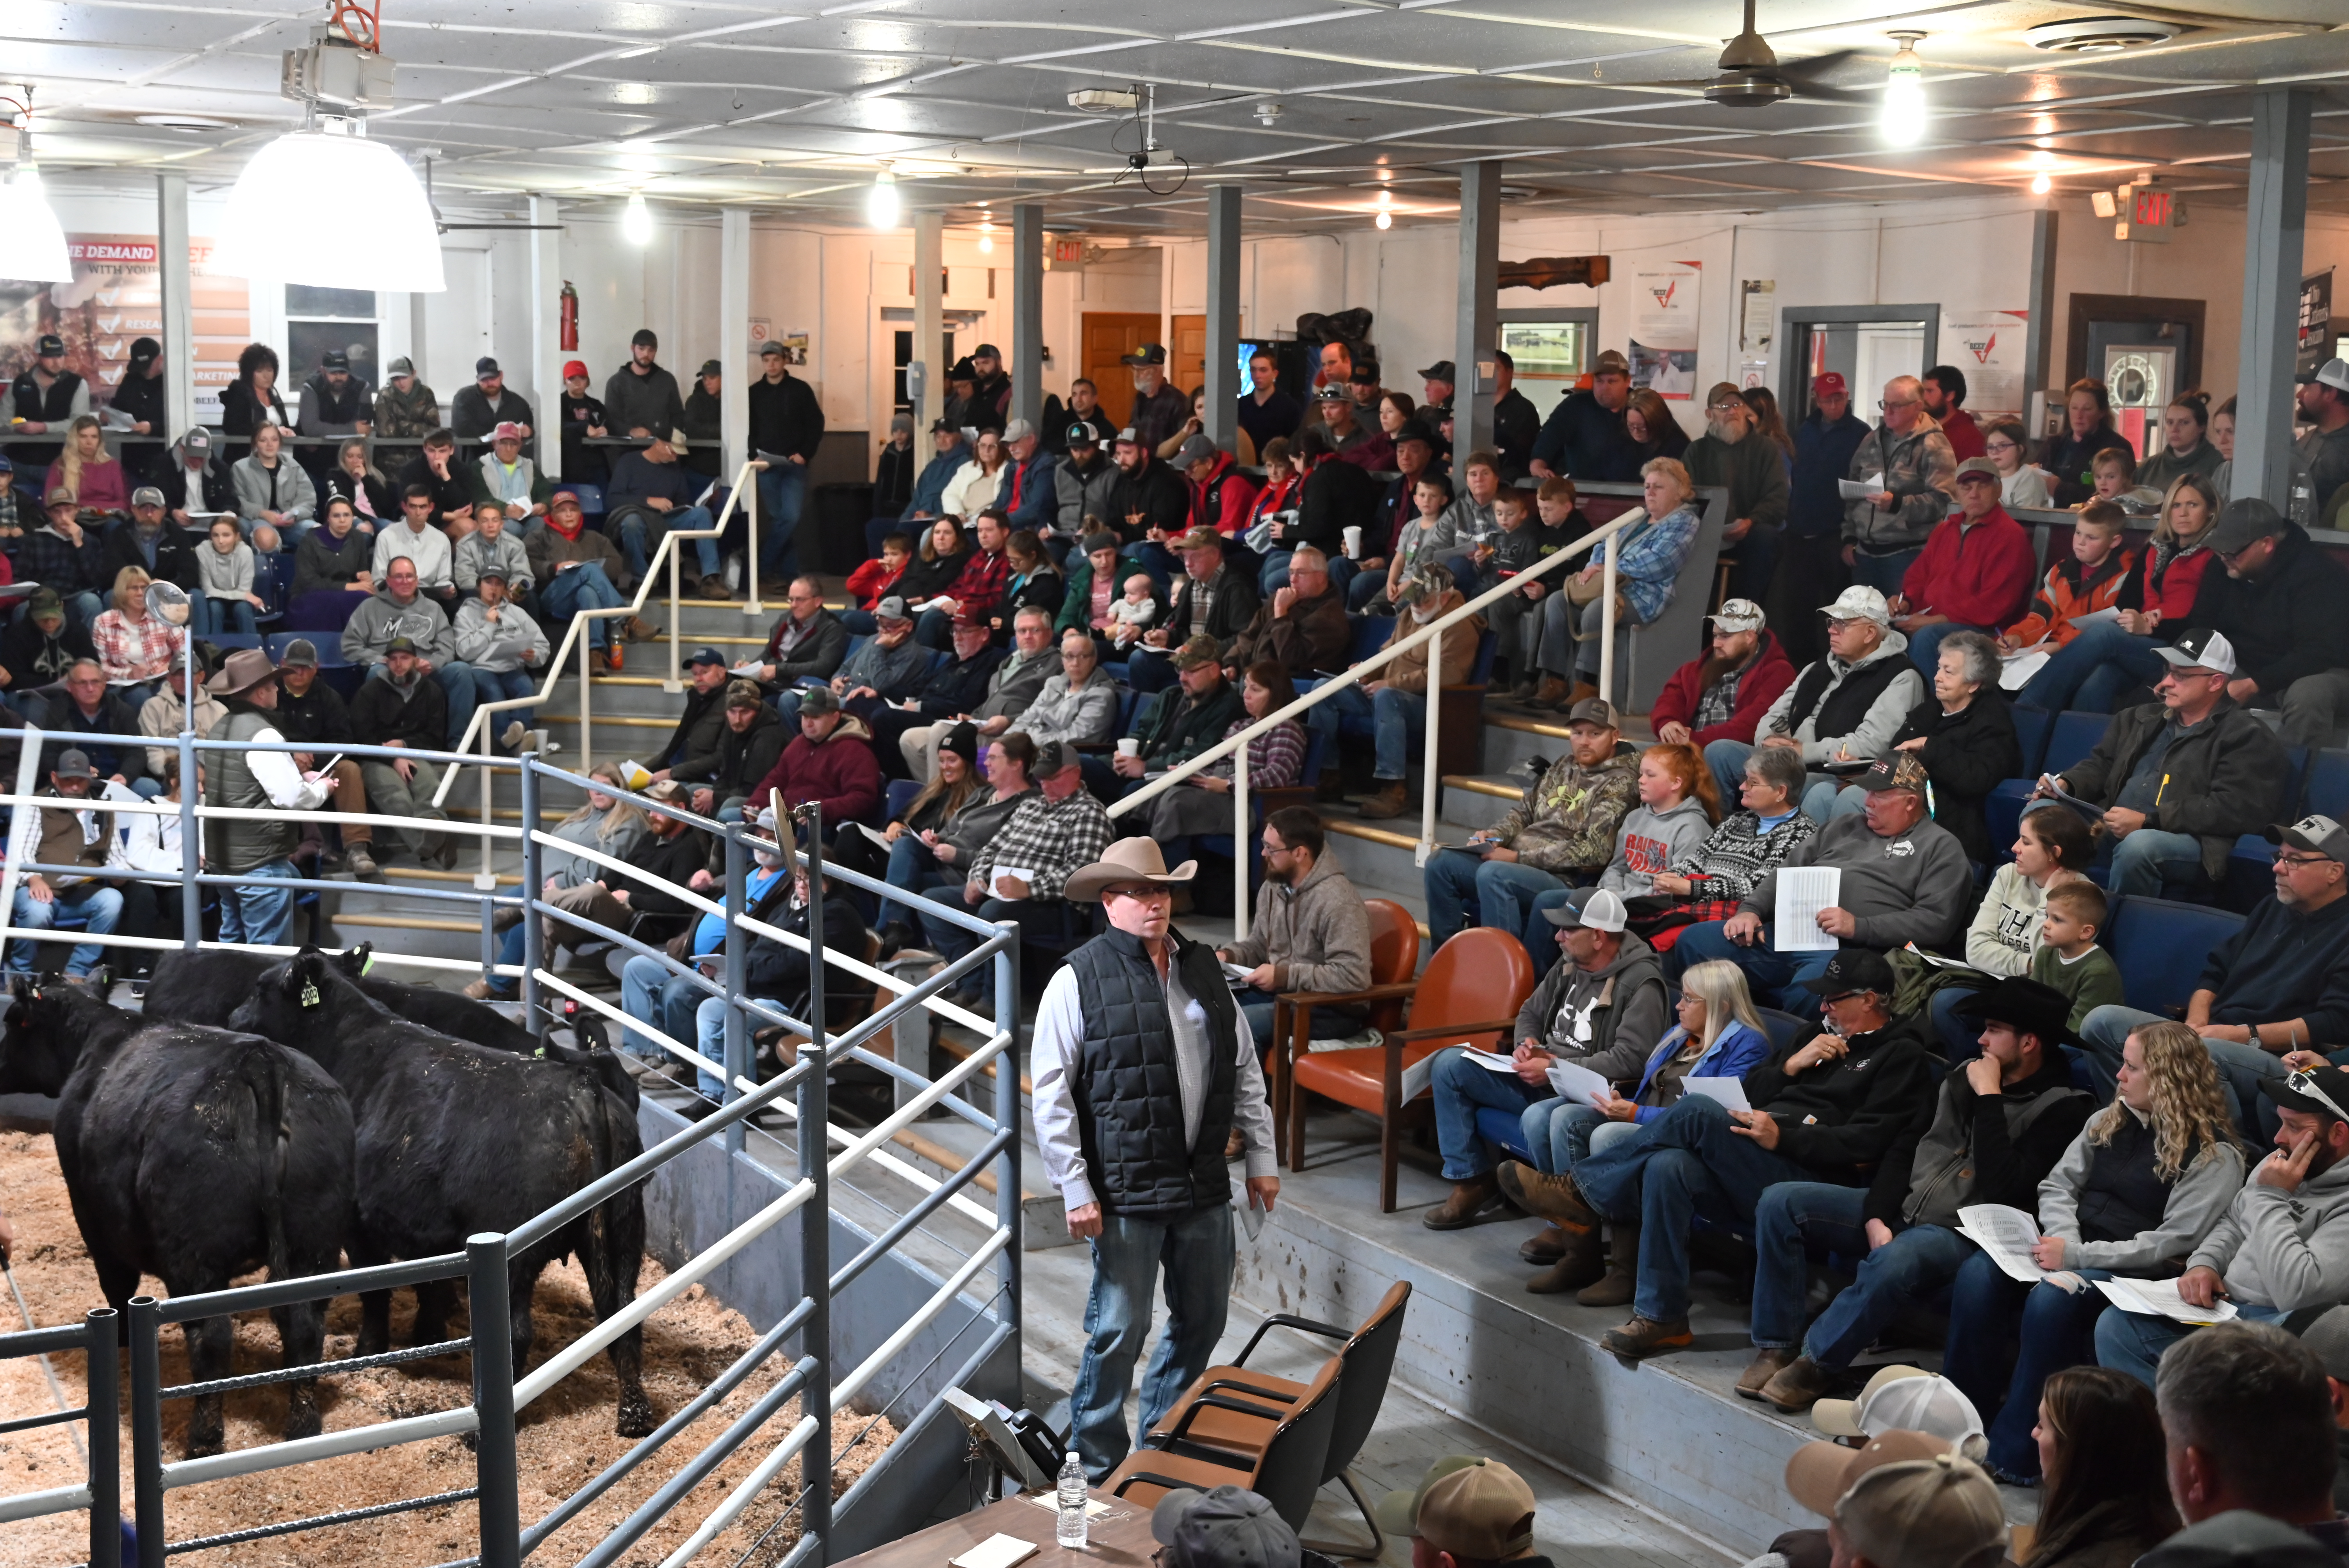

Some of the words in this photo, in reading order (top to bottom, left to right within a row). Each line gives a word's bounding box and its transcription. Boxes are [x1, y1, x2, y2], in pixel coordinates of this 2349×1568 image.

[2137, 191, 2170, 226] EXIT
[67, 246, 84, 258] HE
[86, 246, 154, 260] DEMAND
[189, 247, 213, 263] EEF
[1057, 241, 1081, 262] EXIT
[88, 264, 122, 274] WITH
[125, 319, 162, 329] RESEA
[194, 372, 240, 381] ARKETIN
[2314, 819, 2326, 832] CATTLE
[1829, 960, 1841, 974] SC
